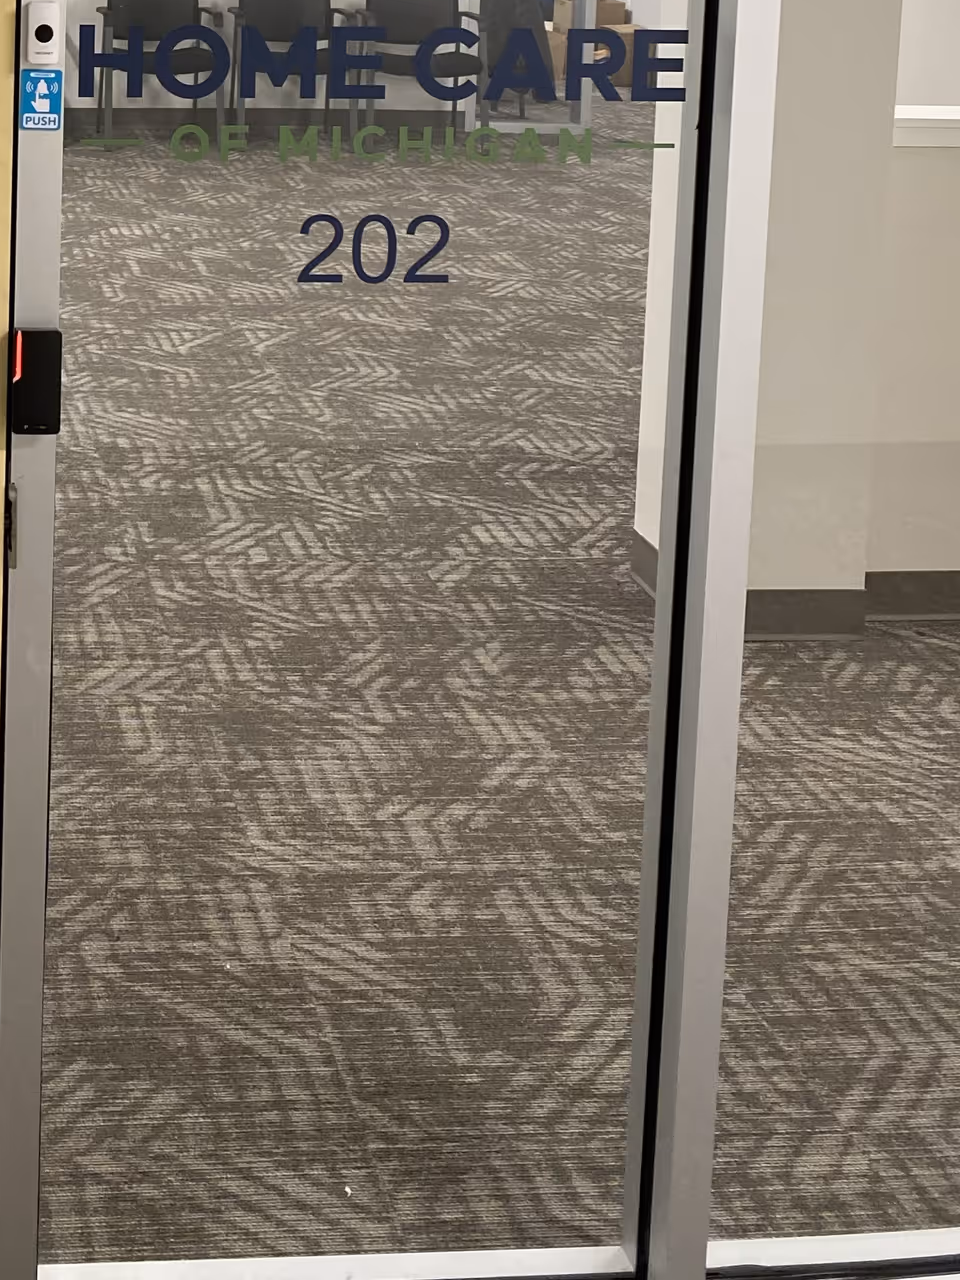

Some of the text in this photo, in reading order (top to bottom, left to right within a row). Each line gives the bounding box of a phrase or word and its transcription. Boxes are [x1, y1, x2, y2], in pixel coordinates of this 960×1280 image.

[77, 24, 689, 102] HOME CARE
[25, 116, 57, 126] PUSH
[170, 123, 592, 164] OF MICHIGAN
[296, 213, 451, 285] 202
